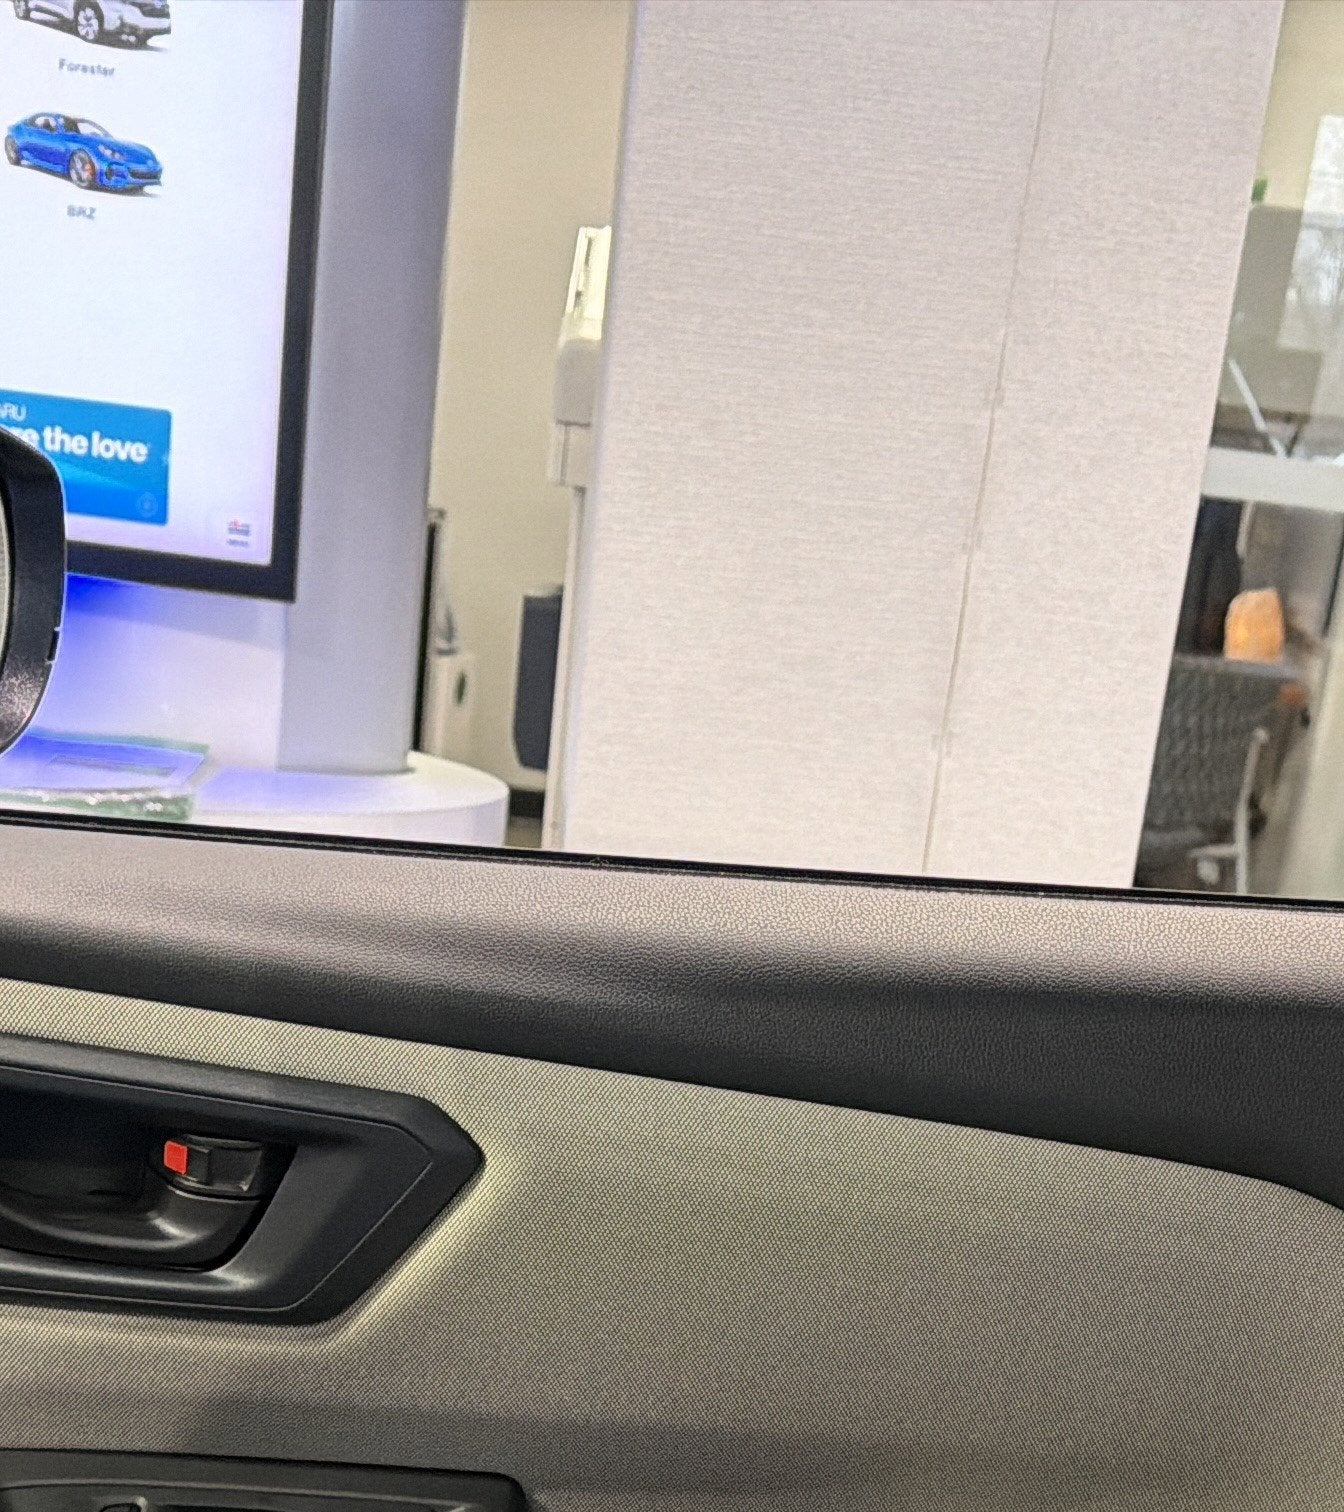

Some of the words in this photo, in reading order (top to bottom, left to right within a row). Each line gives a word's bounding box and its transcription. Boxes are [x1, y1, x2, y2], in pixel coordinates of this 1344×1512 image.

[58, 59, 116, 77] Forester
[43, 425, 87, 456] the
[91, 430, 149, 463] love
